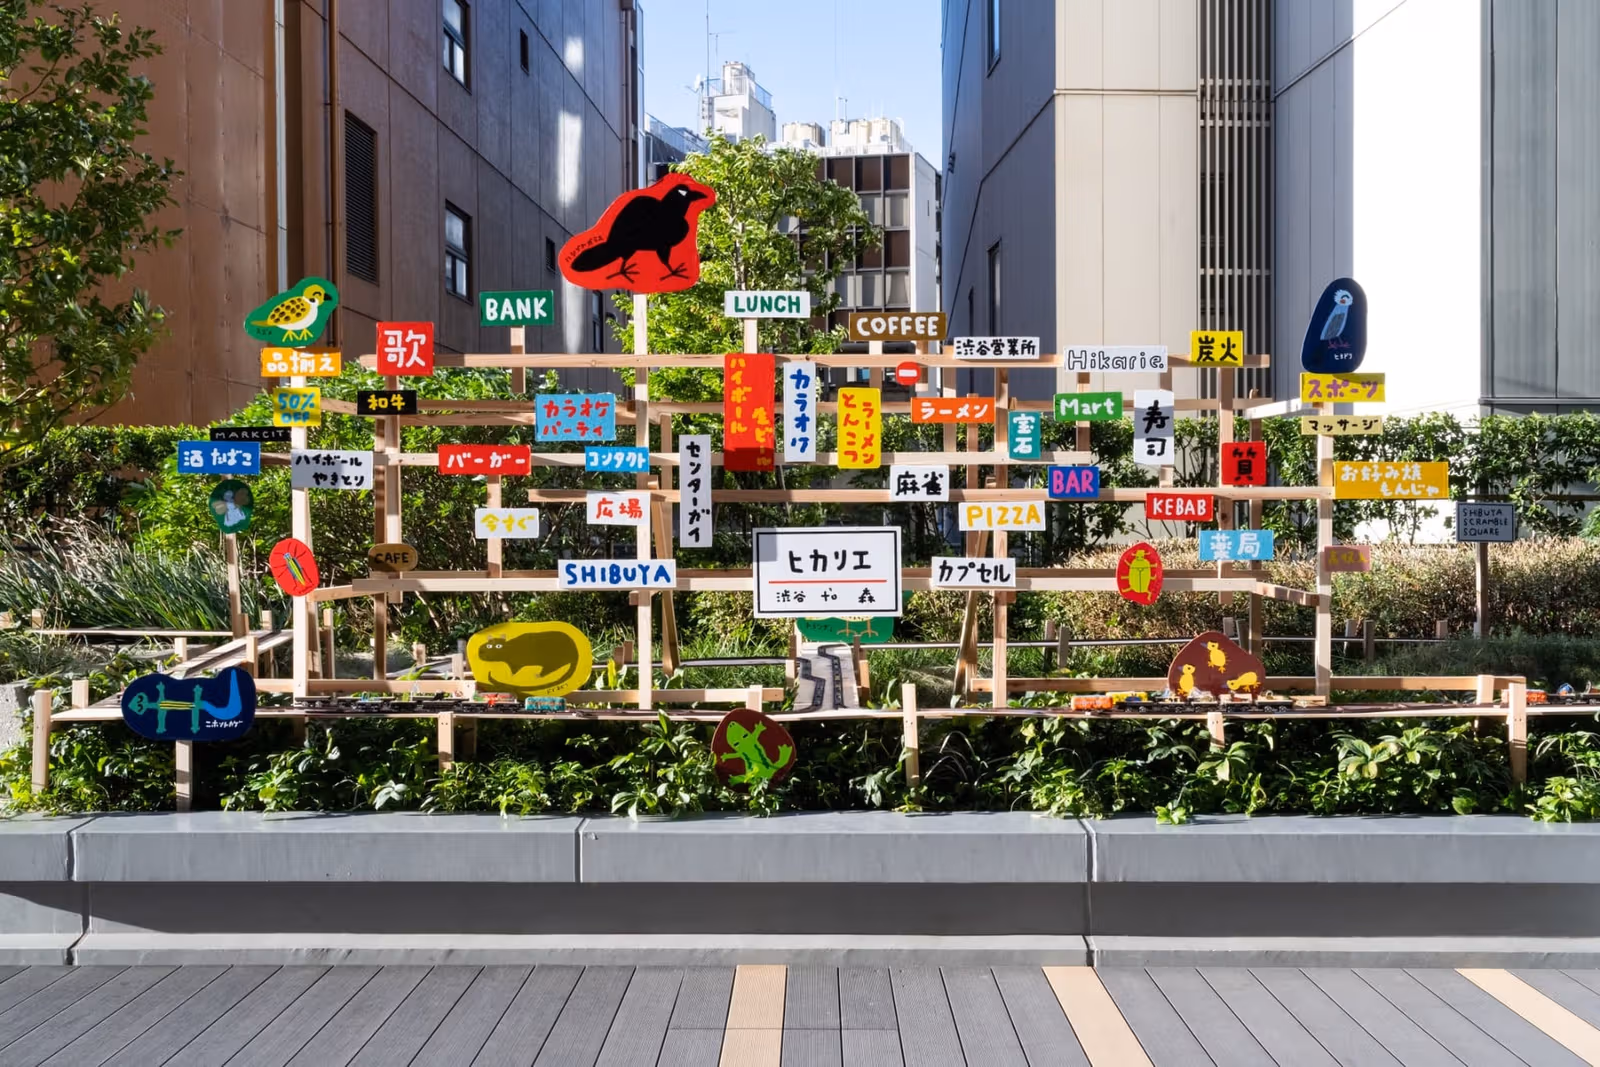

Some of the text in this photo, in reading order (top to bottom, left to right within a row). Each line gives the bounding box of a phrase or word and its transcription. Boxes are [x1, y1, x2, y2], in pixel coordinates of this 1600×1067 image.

[486, 297, 547, 321] BANK
[734, 295, 800, 313] LUNCH
[856, 315, 939, 337] COFFEE
[384, 329, 426, 368] 歌
[956, 338, 1036, 357] 渋谷営業所
[1197, 335, 1238, 362] 炭火
[266, 353, 335, 373] 品揃え
[730, 358, 752, 434] ハイボール
[1308, 379, 1378, 398] スポーツ
[278, 393, 315, 409] 50%
[367, 394, 406, 411] 和牛
[542, 399, 611, 418] カラオケ
[921, 402, 988, 418] ラーメン
[1060, 398, 1115, 416] Mart
[281, 412, 310, 423] OFF
[1308, 418, 1379, 432] マッサージ
[1013, 413, 1035, 454] 宝石
[1143, 400, 1169, 456] 寿司
[183, 448, 252, 467] 酒 たばこ
[296, 453, 362, 467] ハイボール
[447, 452, 526, 468] バーガー
[589, 451, 646, 469] コンタクト
[313, 472, 364, 487] やきとり
[1052, 469, 1094, 494] BAR
[1341, 464, 1422, 482] お好み焼
[686, 441, 710, 543] センターガイ
[896, 471, 944, 496] 麻雀
[1380, 482, 1440, 497] もんじゃ
[596, 498, 643, 519] 広場
[966, 505, 1040, 527] PIZZA
[1152, 498, 1206, 516] KEBAB
[1462, 508, 1503, 517] SHIBUYA
[481, 513, 535, 532] 今すぐ
[1463, 517, 1508, 527] SCRAMBLE
[1463, 527, 1500, 536] SQUARE
[1210, 532, 1260, 559] 薬局
[374, 552, 409, 564] CAFE
[788, 549, 872, 573] ヒカリエ
[566, 564, 671, 585] SHIBUYA
[938, 560, 1011, 583] カプセル
[776, 589, 806, 603] 渋谷
[858, 587, 876, 604] 森
